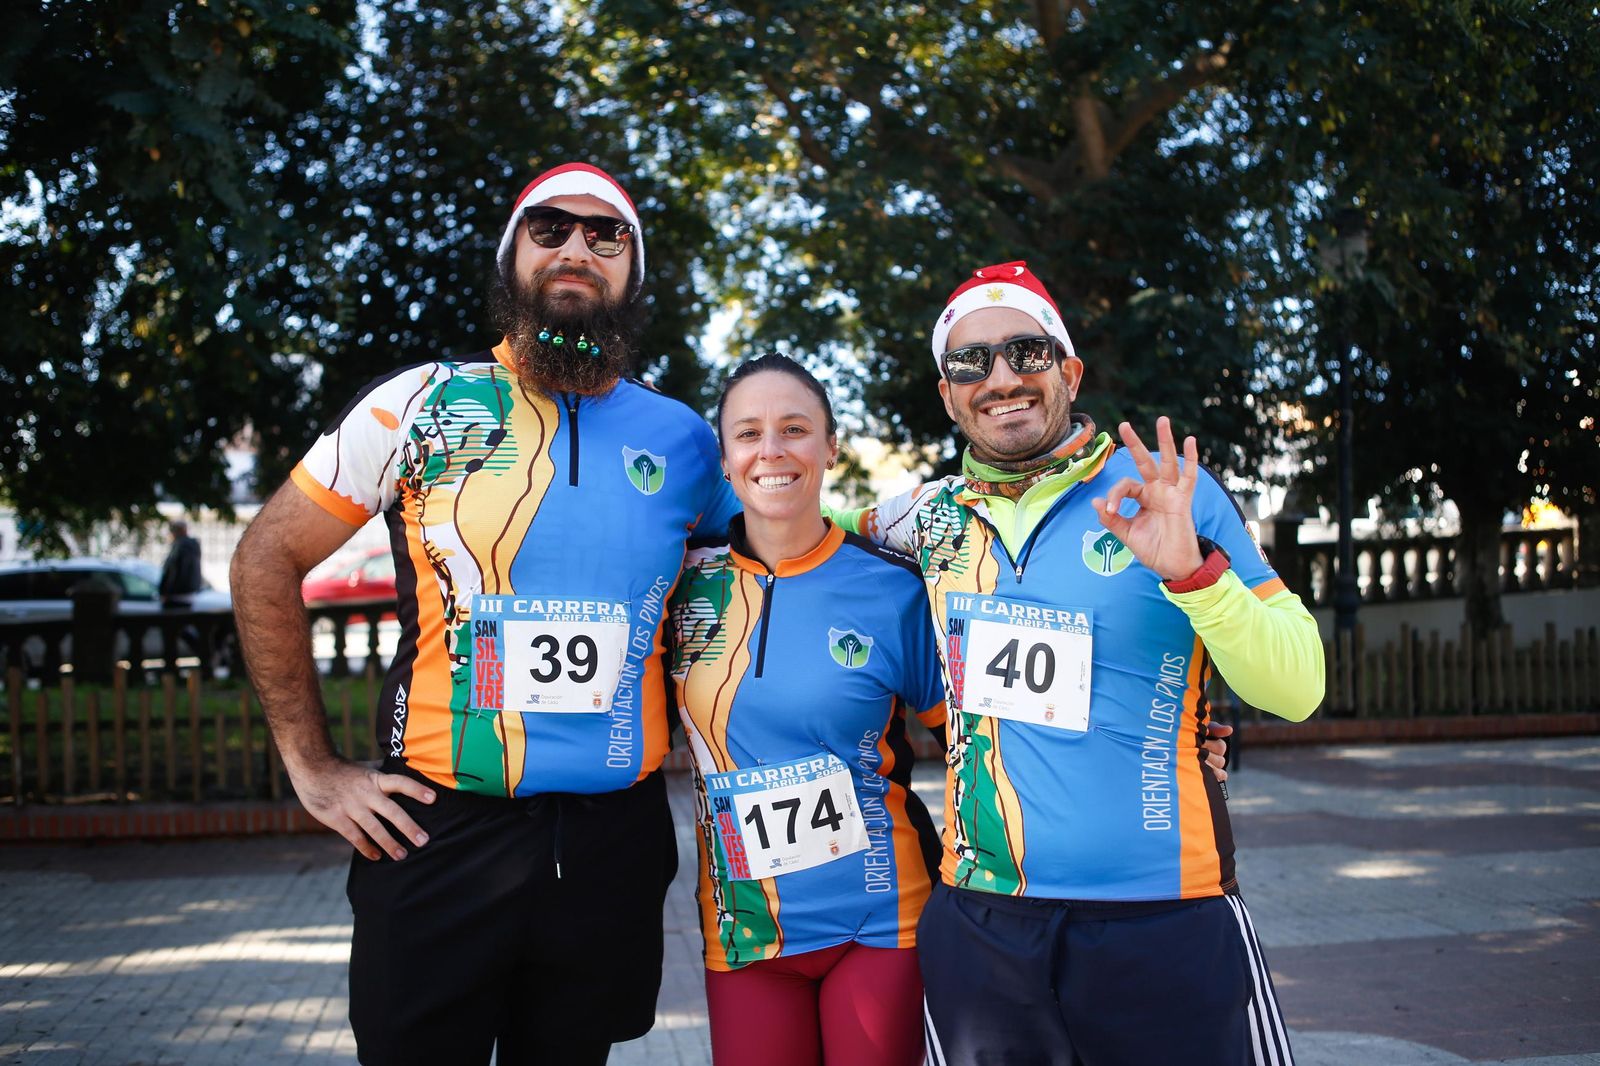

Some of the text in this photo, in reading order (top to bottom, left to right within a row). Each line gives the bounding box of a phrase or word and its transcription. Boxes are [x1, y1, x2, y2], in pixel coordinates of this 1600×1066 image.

[479, 599, 628, 616] III CARRERA
[543, 613, 627, 624] TARIFA 2024
[952, 597, 1090, 626] III CARRERA
[474, 619, 497, 638] SAN
[948, 617, 965, 637] SAN
[1008, 617, 1090, 635] TARIFA 2024
[475, 638, 498, 661] SIL
[628, 626, 651, 660] LOS
[948, 635, 962, 661] SIL
[529, 634, 598, 684] 39
[985, 638, 1056, 694] 40
[476, 661, 503, 686] VES
[475, 684, 504, 709] TRE
[1146, 698, 1177, 734] LOS
[712, 753, 841, 790] III CARRERA
[764, 764, 845, 790] TARIFA 2024
[714, 796, 731, 814] SAN
[717, 813, 737, 835] SIL
[744, 788, 844, 850] 174
[722, 833, 746, 857] VES
[862, 797, 892, 893] ORIENTACION
[727, 855, 750, 879] TRE
